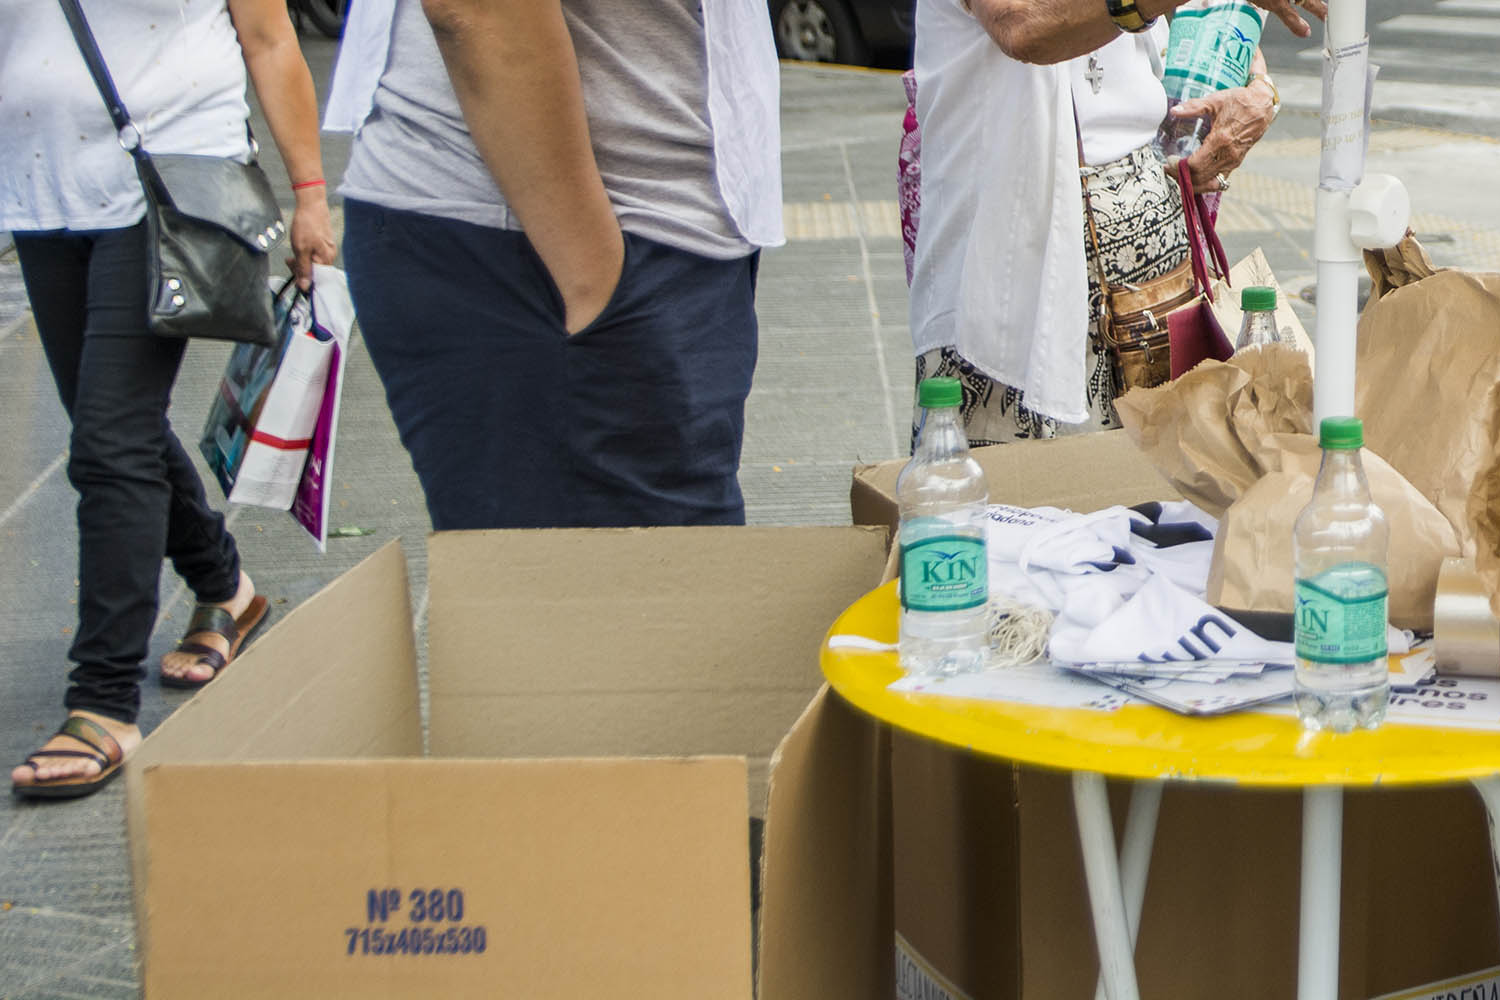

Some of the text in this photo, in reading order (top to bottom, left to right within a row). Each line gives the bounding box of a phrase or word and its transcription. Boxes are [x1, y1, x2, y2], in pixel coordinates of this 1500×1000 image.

[921, 556, 978, 584] KIN
[1300, 607, 1331, 633] IN
[1389, 695, 1466, 710] ires
[409, 887, 464, 923] 380
[344, 925, 488, 956] 715x405x530
